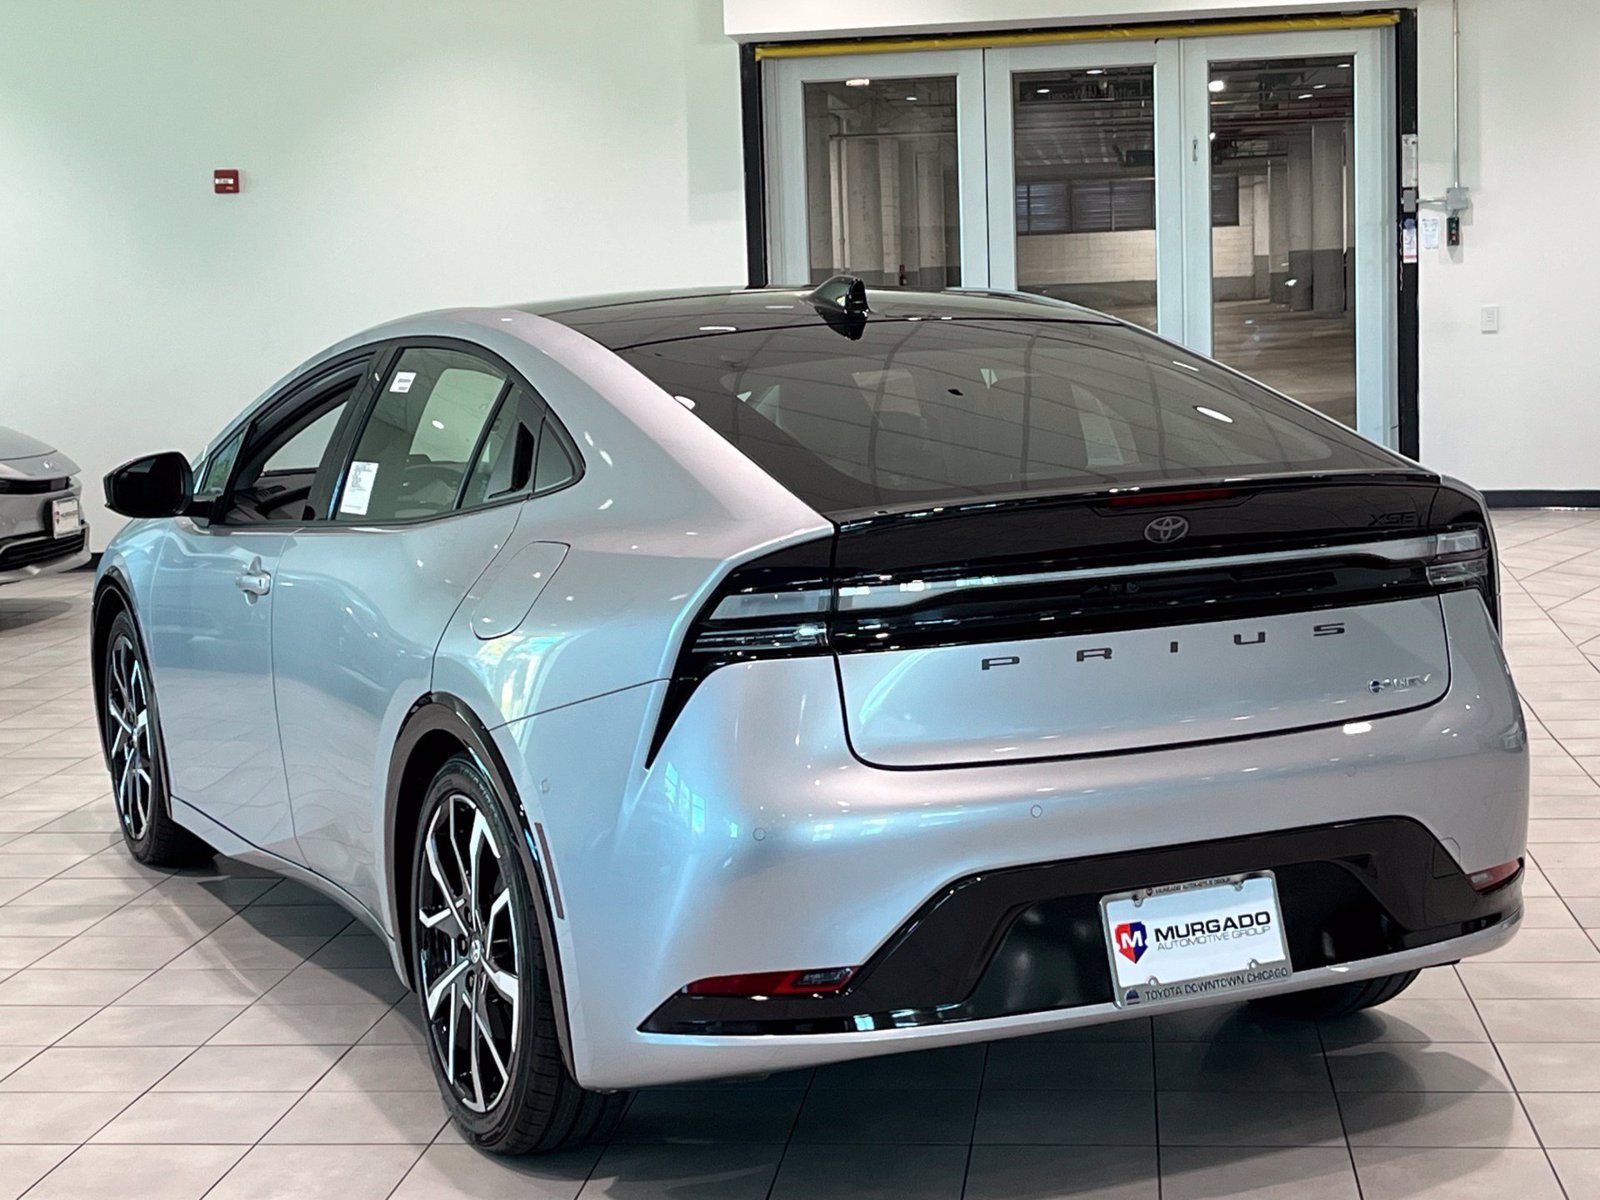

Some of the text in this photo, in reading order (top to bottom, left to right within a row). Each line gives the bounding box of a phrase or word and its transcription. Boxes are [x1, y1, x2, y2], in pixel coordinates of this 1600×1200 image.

[1368, 511, 1417, 526] XSE
[982, 622, 1345, 670] PRIUS
[1154, 911, 1271, 942] MURGADO
[1157, 925, 1271, 951] AUTOMOTIVE GROUP
[1145, 967, 1288, 1001] TOYOTA DOWNTOWN CHICAGO
